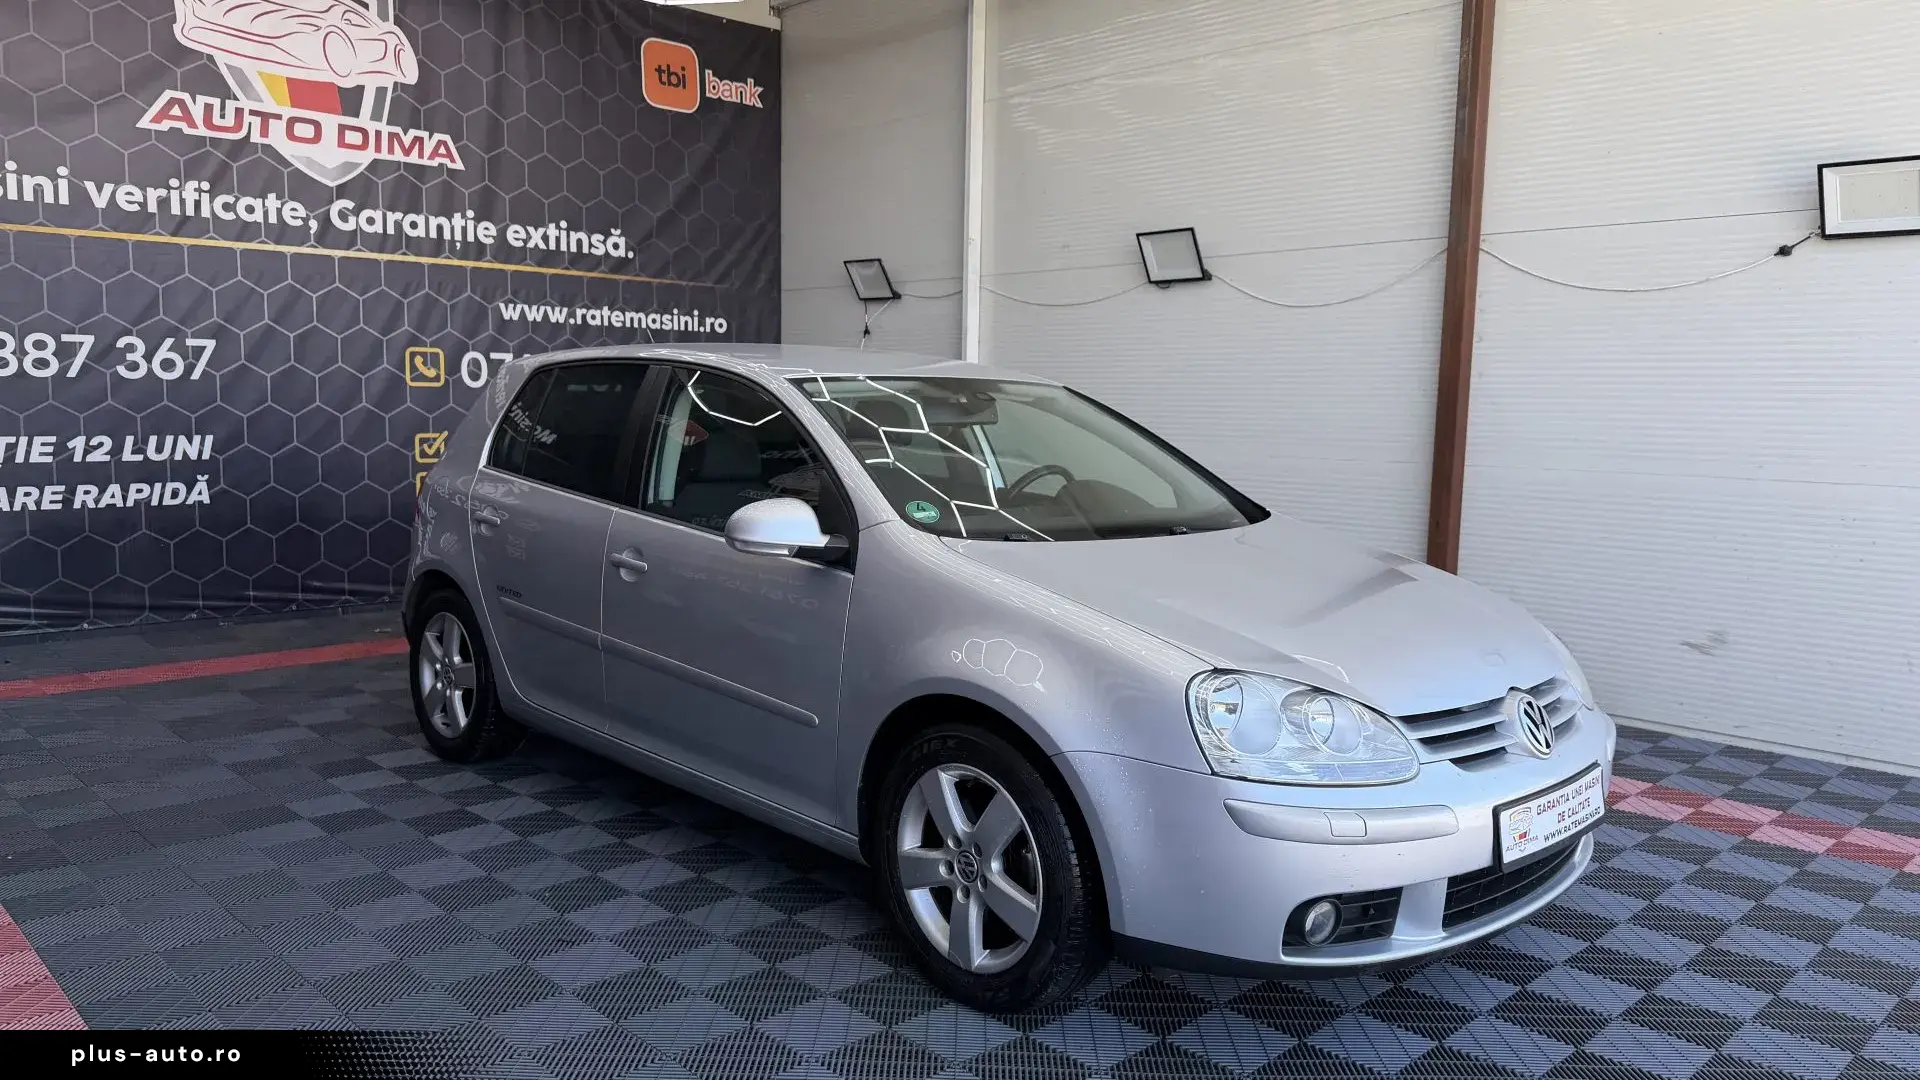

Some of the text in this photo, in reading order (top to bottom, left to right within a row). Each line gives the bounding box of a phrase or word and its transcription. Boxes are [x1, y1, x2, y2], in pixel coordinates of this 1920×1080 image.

[655, 64, 764, 109] tbi bank
[148, 96, 457, 164] AUTO DIMA
[0, 160, 634, 259] ini verificate, Garanție extinsă.
[499, 303, 728, 334] www.ratemasini.ro
[115, 335, 217, 380] 367
[461, 351, 532, 388] 07
[66, 435, 113, 462] 12
[121, 434, 214, 462] LUNI
[73, 474, 211, 509] RAPIDĂ
[1537, 792, 1570, 816] GARANTIA
[1557, 797, 1591, 824] DE CALITATE
[1505, 841, 1523, 853] AUTO
